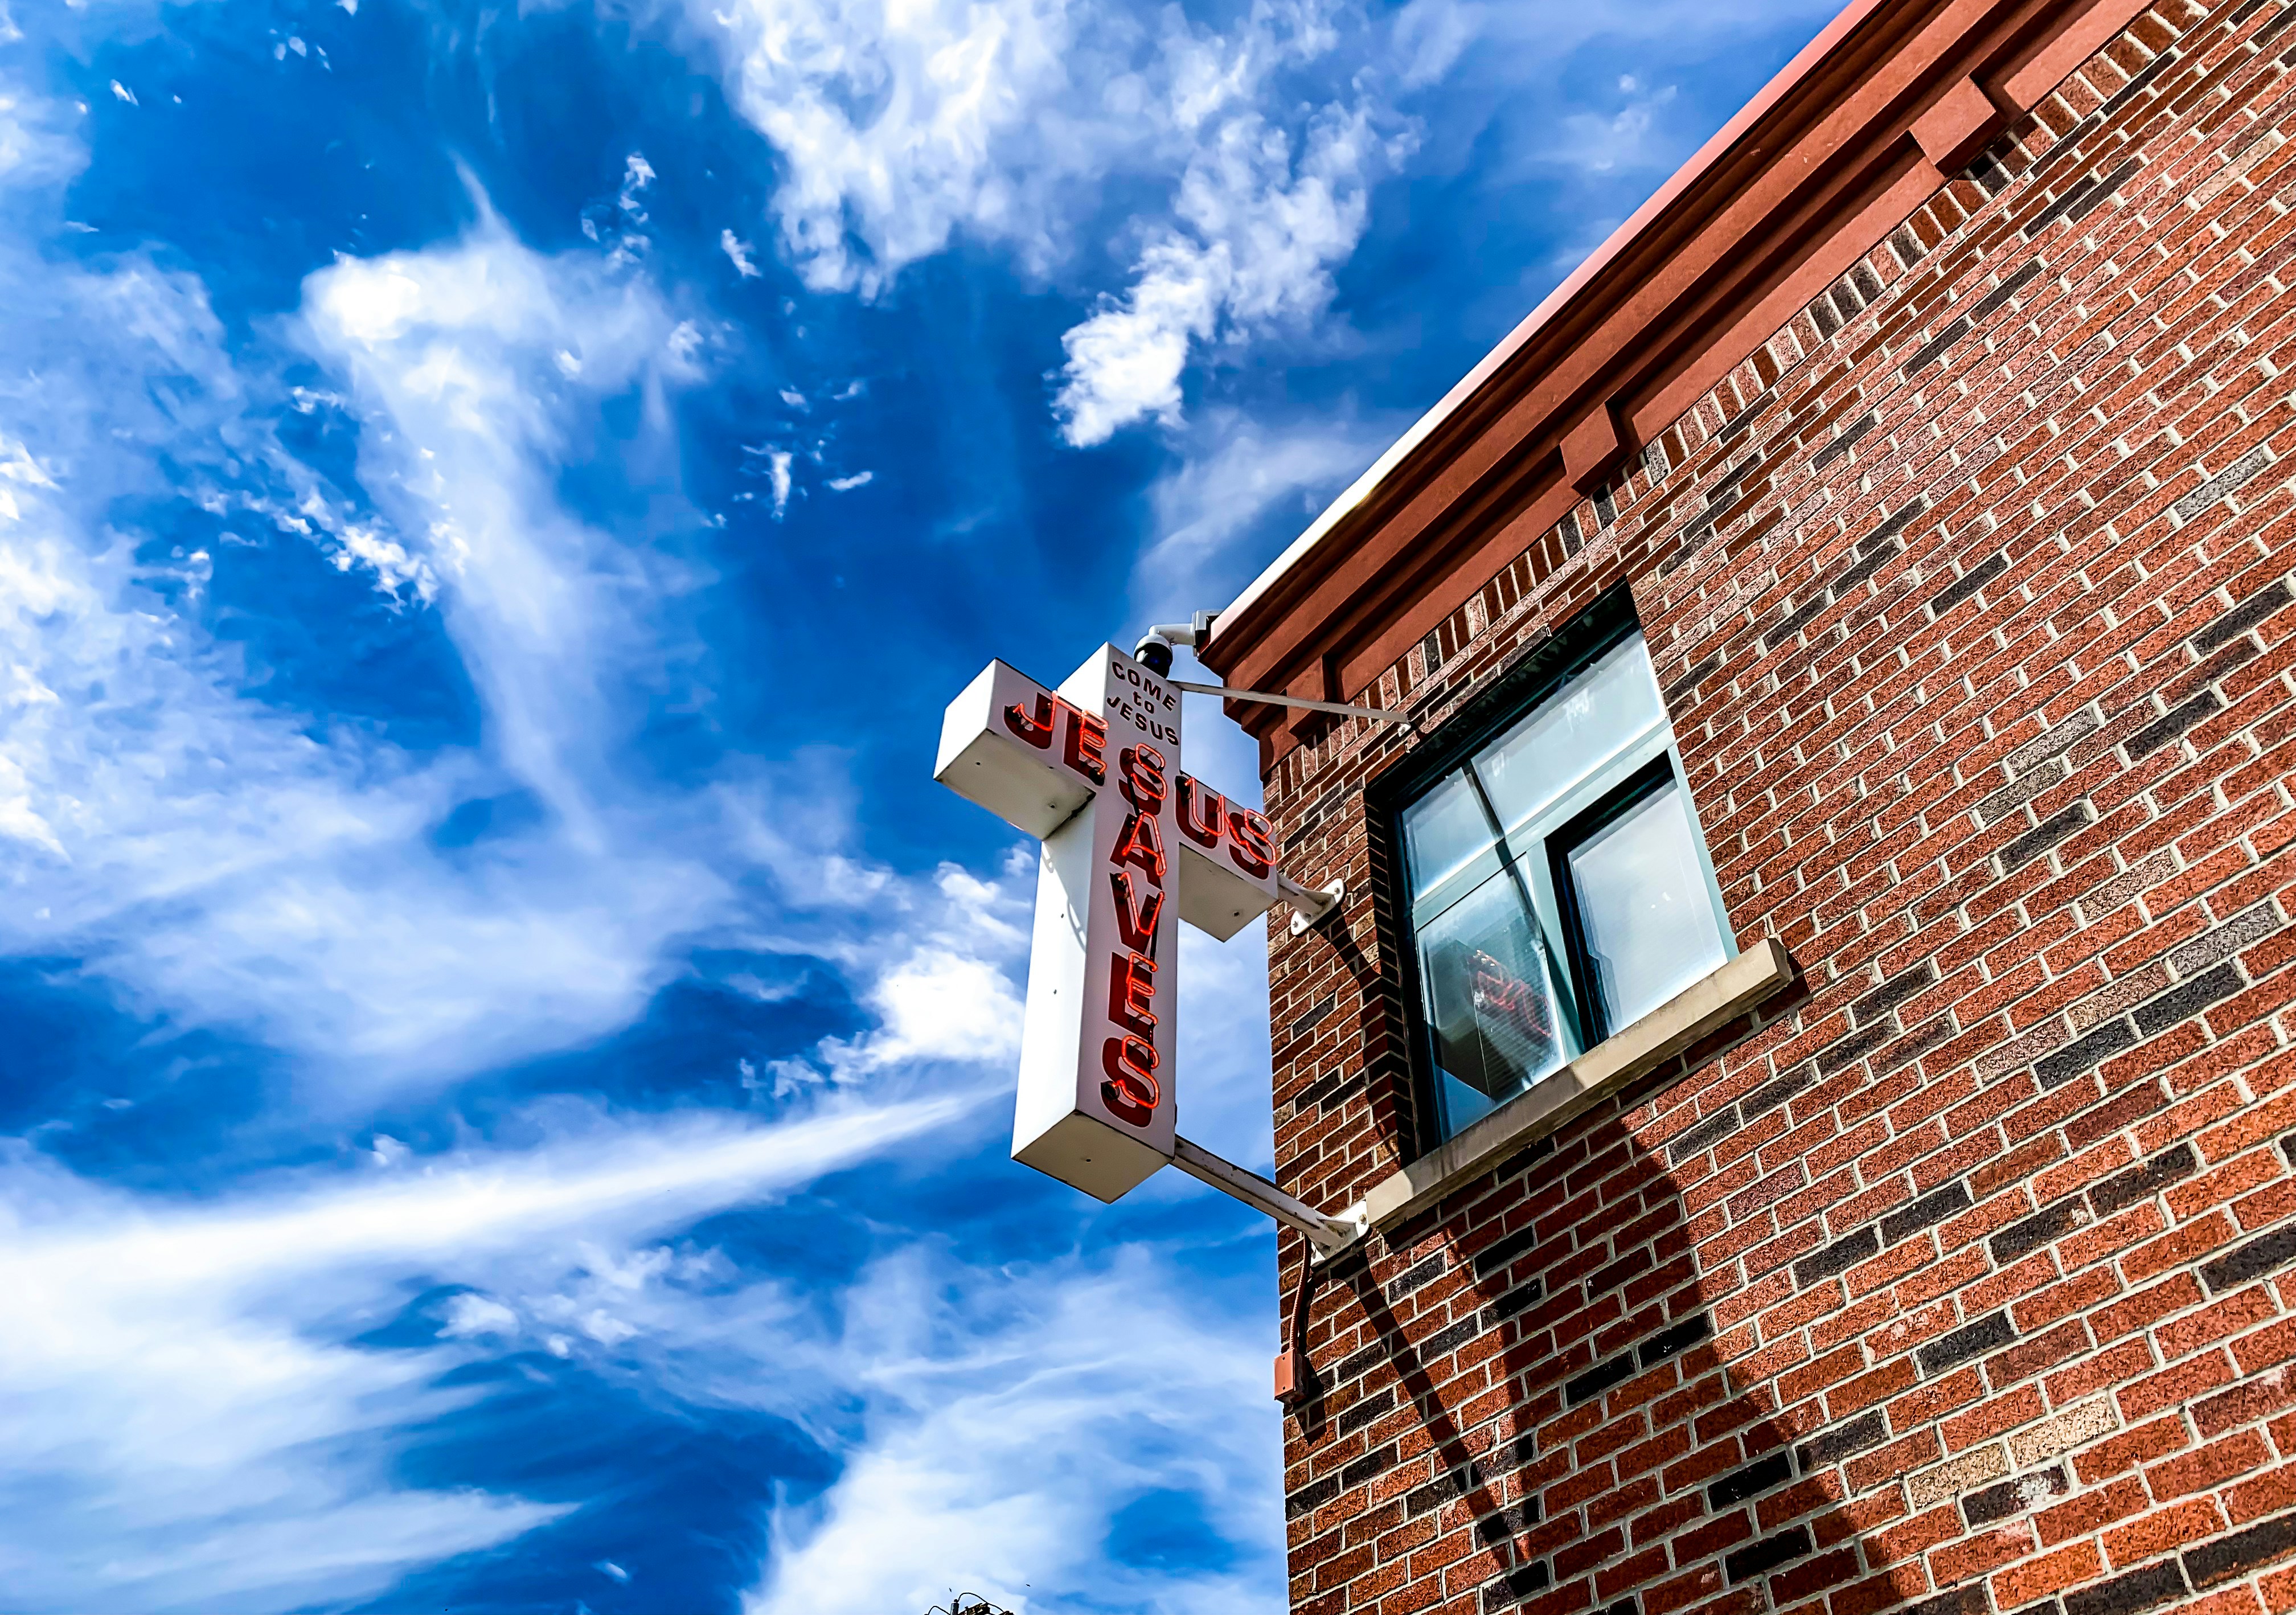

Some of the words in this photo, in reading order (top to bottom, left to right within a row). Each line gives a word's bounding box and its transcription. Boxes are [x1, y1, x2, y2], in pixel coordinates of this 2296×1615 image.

[1112, 662, 1176, 712] COME
[1133, 691, 1155, 714] to
[1106, 696, 1179, 745] JESUS
[1003, 691, 1276, 880] JESUS
[1100, 743, 1167, 1128] SAVES
